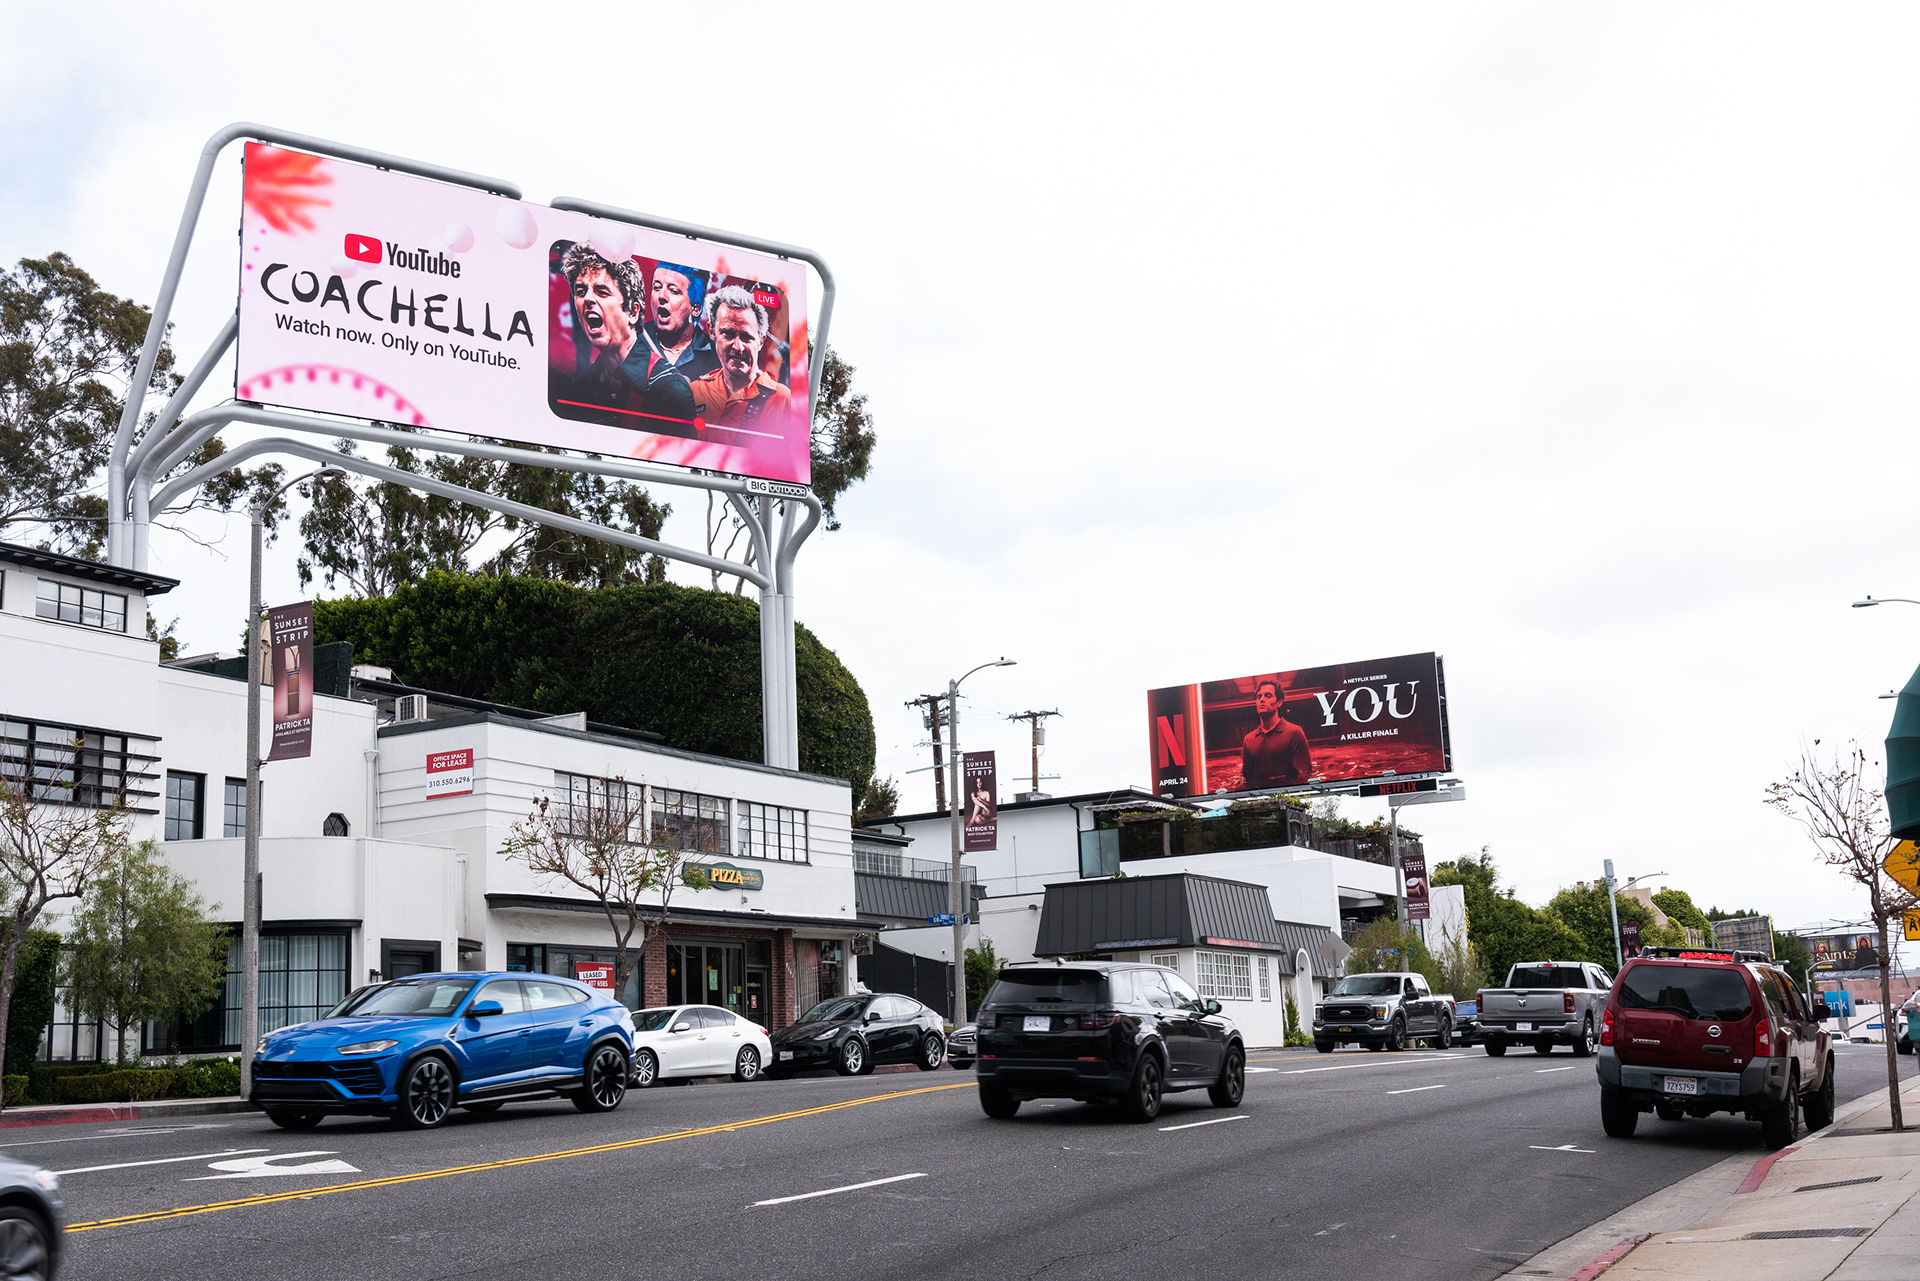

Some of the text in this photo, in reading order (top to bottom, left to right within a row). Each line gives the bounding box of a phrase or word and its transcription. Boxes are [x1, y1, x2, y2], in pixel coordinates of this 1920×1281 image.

[386, 241, 461, 279] YouTube
[261, 262, 534, 347] COACHELLA
[758, 294, 775, 305] LIVE
[275, 312, 521, 370] Watch now. Only on YouTube.
[751, 481, 806, 496] BIG OUTDOOR
[274, 616, 308, 630] SUNSET
[276, 630, 308, 644] STRIP
[1347, 676, 1370, 684] NETFLIX
[1369, 673, 1388, 681] SERIES
[1313, 680, 1419, 727] YOU
[275, 718, 310, 731] PATRICK TA
[1347, 731, 1372, 740] KILLER
[1372, 728, 1399, 737] FINALE
[432, 758, 467, 769] FOR LEASE
[433, 752, 467, 763] OFFICE SPACE
[966, 760, 992, 768] SUNSET
[429, 776, 471, 788] 310.550.6296
[1159, 778, 1179, 787] APRIL
[1380, 781, 1417, 795] NETFLIX
[710, 868, 743, 884] PIZZA
[582, 971, 603, 979] LEASED
[1666, 1080, 1696, 1092] 7ZYS759
